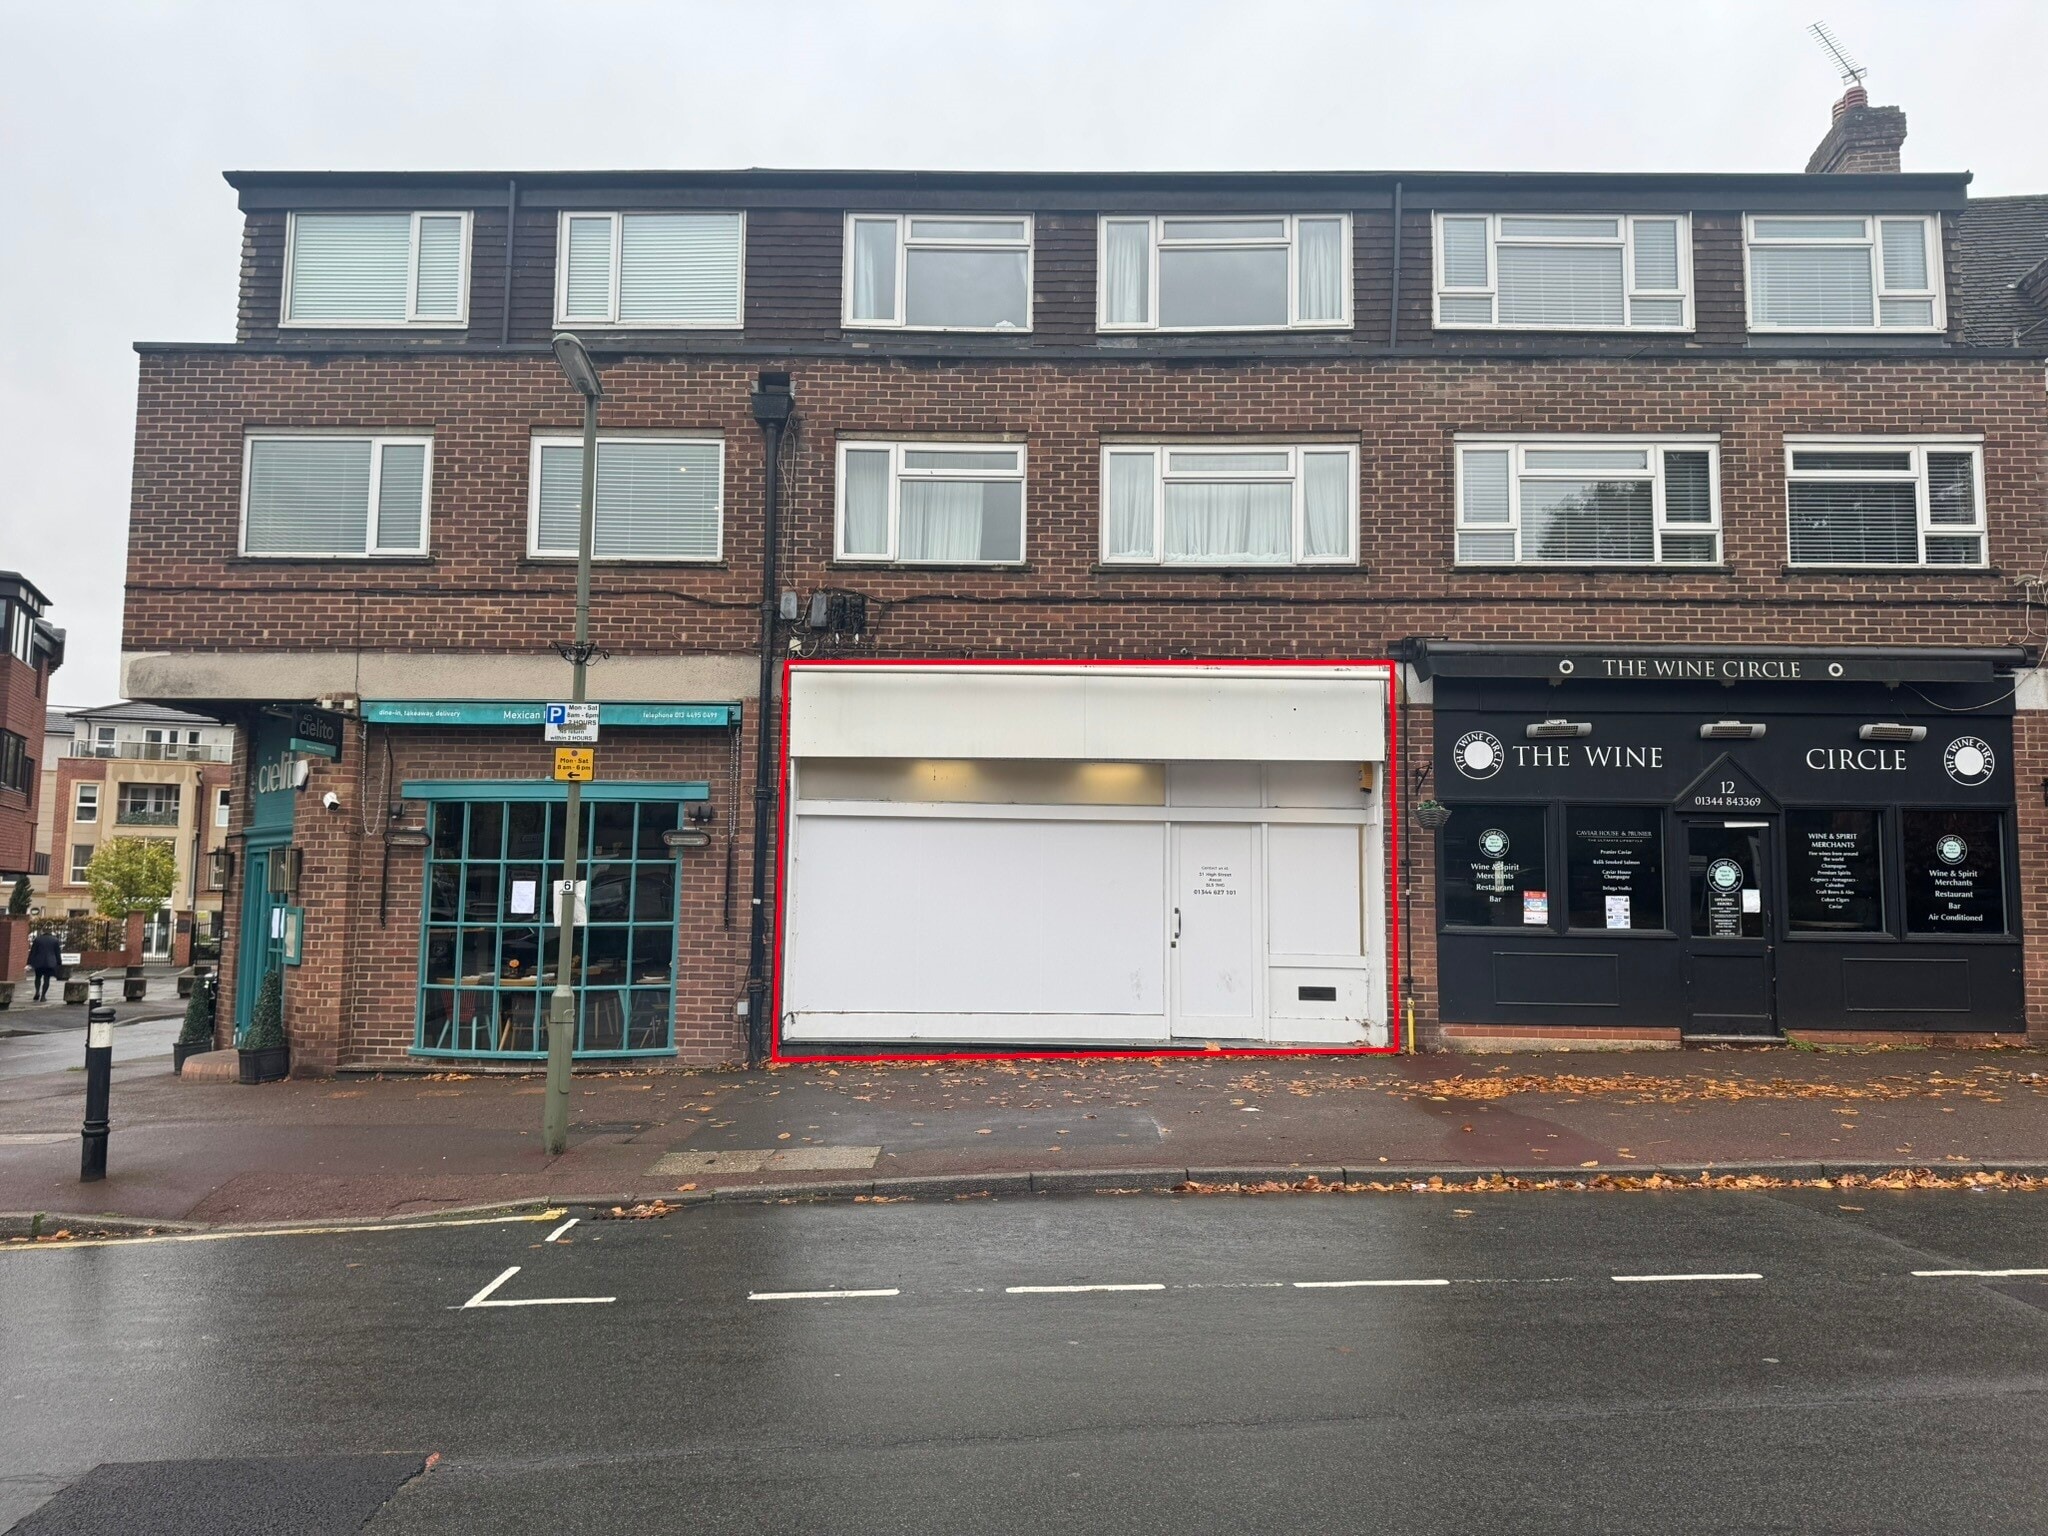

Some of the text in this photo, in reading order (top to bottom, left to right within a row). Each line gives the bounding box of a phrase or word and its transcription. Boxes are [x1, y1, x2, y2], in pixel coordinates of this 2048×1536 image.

[1602, 660, 1800, 678] THE WINE CIRCLE
[504, 711, 540, 719] Mexican
[550, 707, 562, 722] P
[300, 717, 334, 740] cielito
[1456, 733, 1501, 769] THE WINE CIRCLE
[1512, 746, 1907, 770] THE WINE CIRCLE
[1946, 739, 1992, 775] THE WINE CIRCLE
[259, 751, 296, 793] cielit
[1721, 781, 1735, 793] 12
[1695, 796, 1761, 806] 01344 843369
[1958, 870, 1978, 879] Spirit
